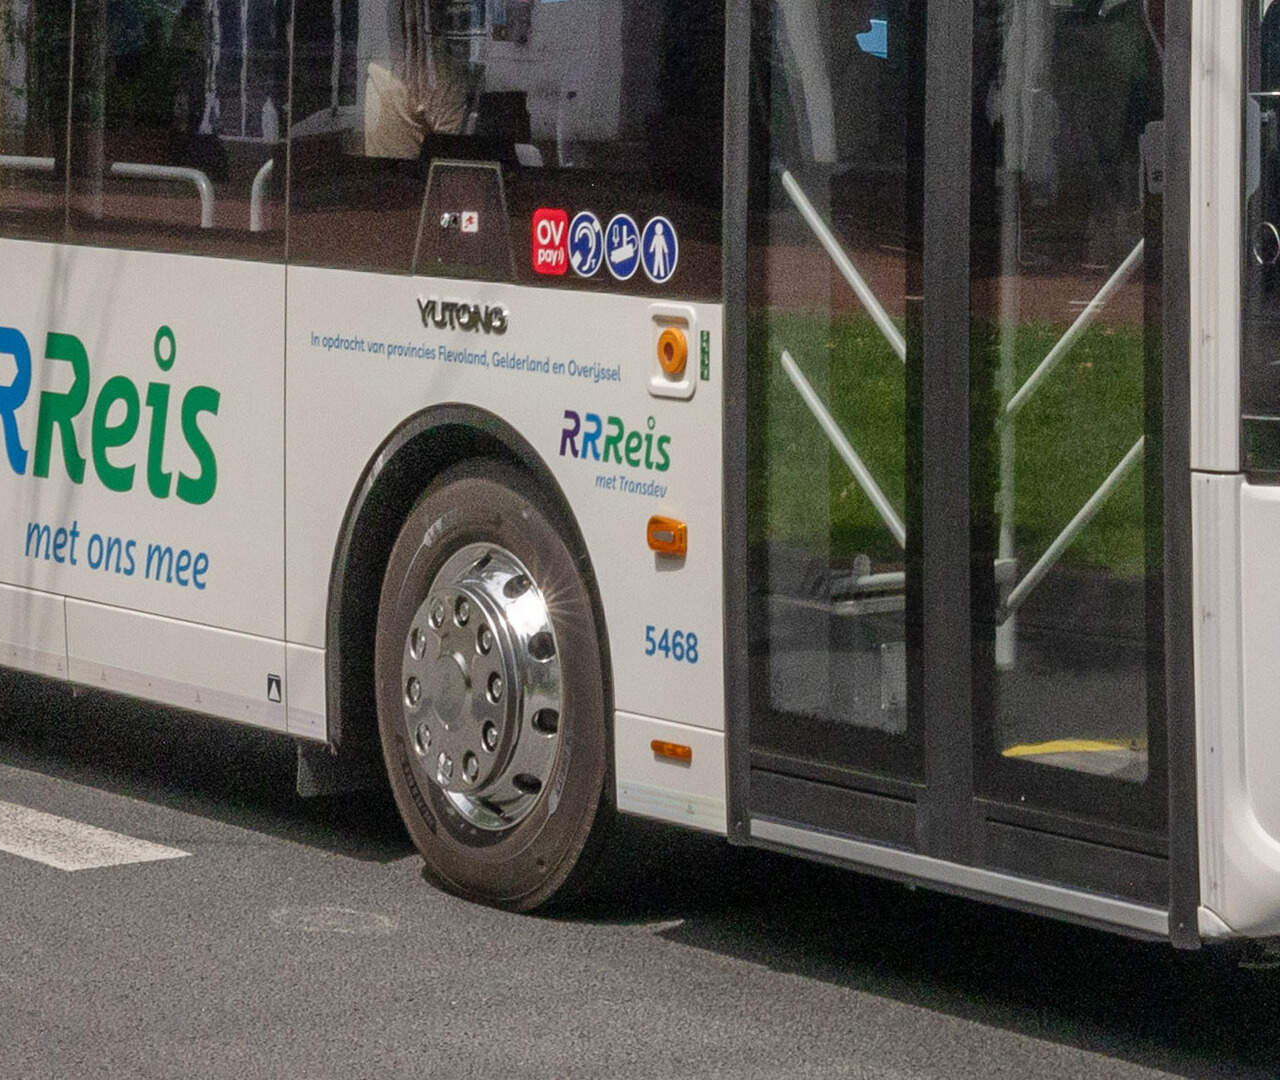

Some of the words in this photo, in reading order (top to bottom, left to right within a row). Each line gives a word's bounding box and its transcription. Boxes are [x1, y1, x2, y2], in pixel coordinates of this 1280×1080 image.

[536, 219, 564, 246] OV
[537, 248, 556, 266] pay
[417, 298, 509, 335] YUTONG
[311, 331, 320, 346] In
[322, 335, 365, 353] opdracht
[367, 341, 385, 354] van
[387, 343, 436, 360] provincies
[439, 346, 489, 368] Flevoland,
[492, 352, 550, 373] Gelderland
[552, 362, 566, 375] en
[568, 360, 622, 384] Overijssel
[560, 409, 671, 472] RRReis
[595, 475, 617, 491] met
[619, 475, 668, 498] Transdev
[25, 520, 79, 566] met
[86, 535, 137, 576] ons
[145, 544, 210, 590] mee
[645, 625, 699, 664] 5468
